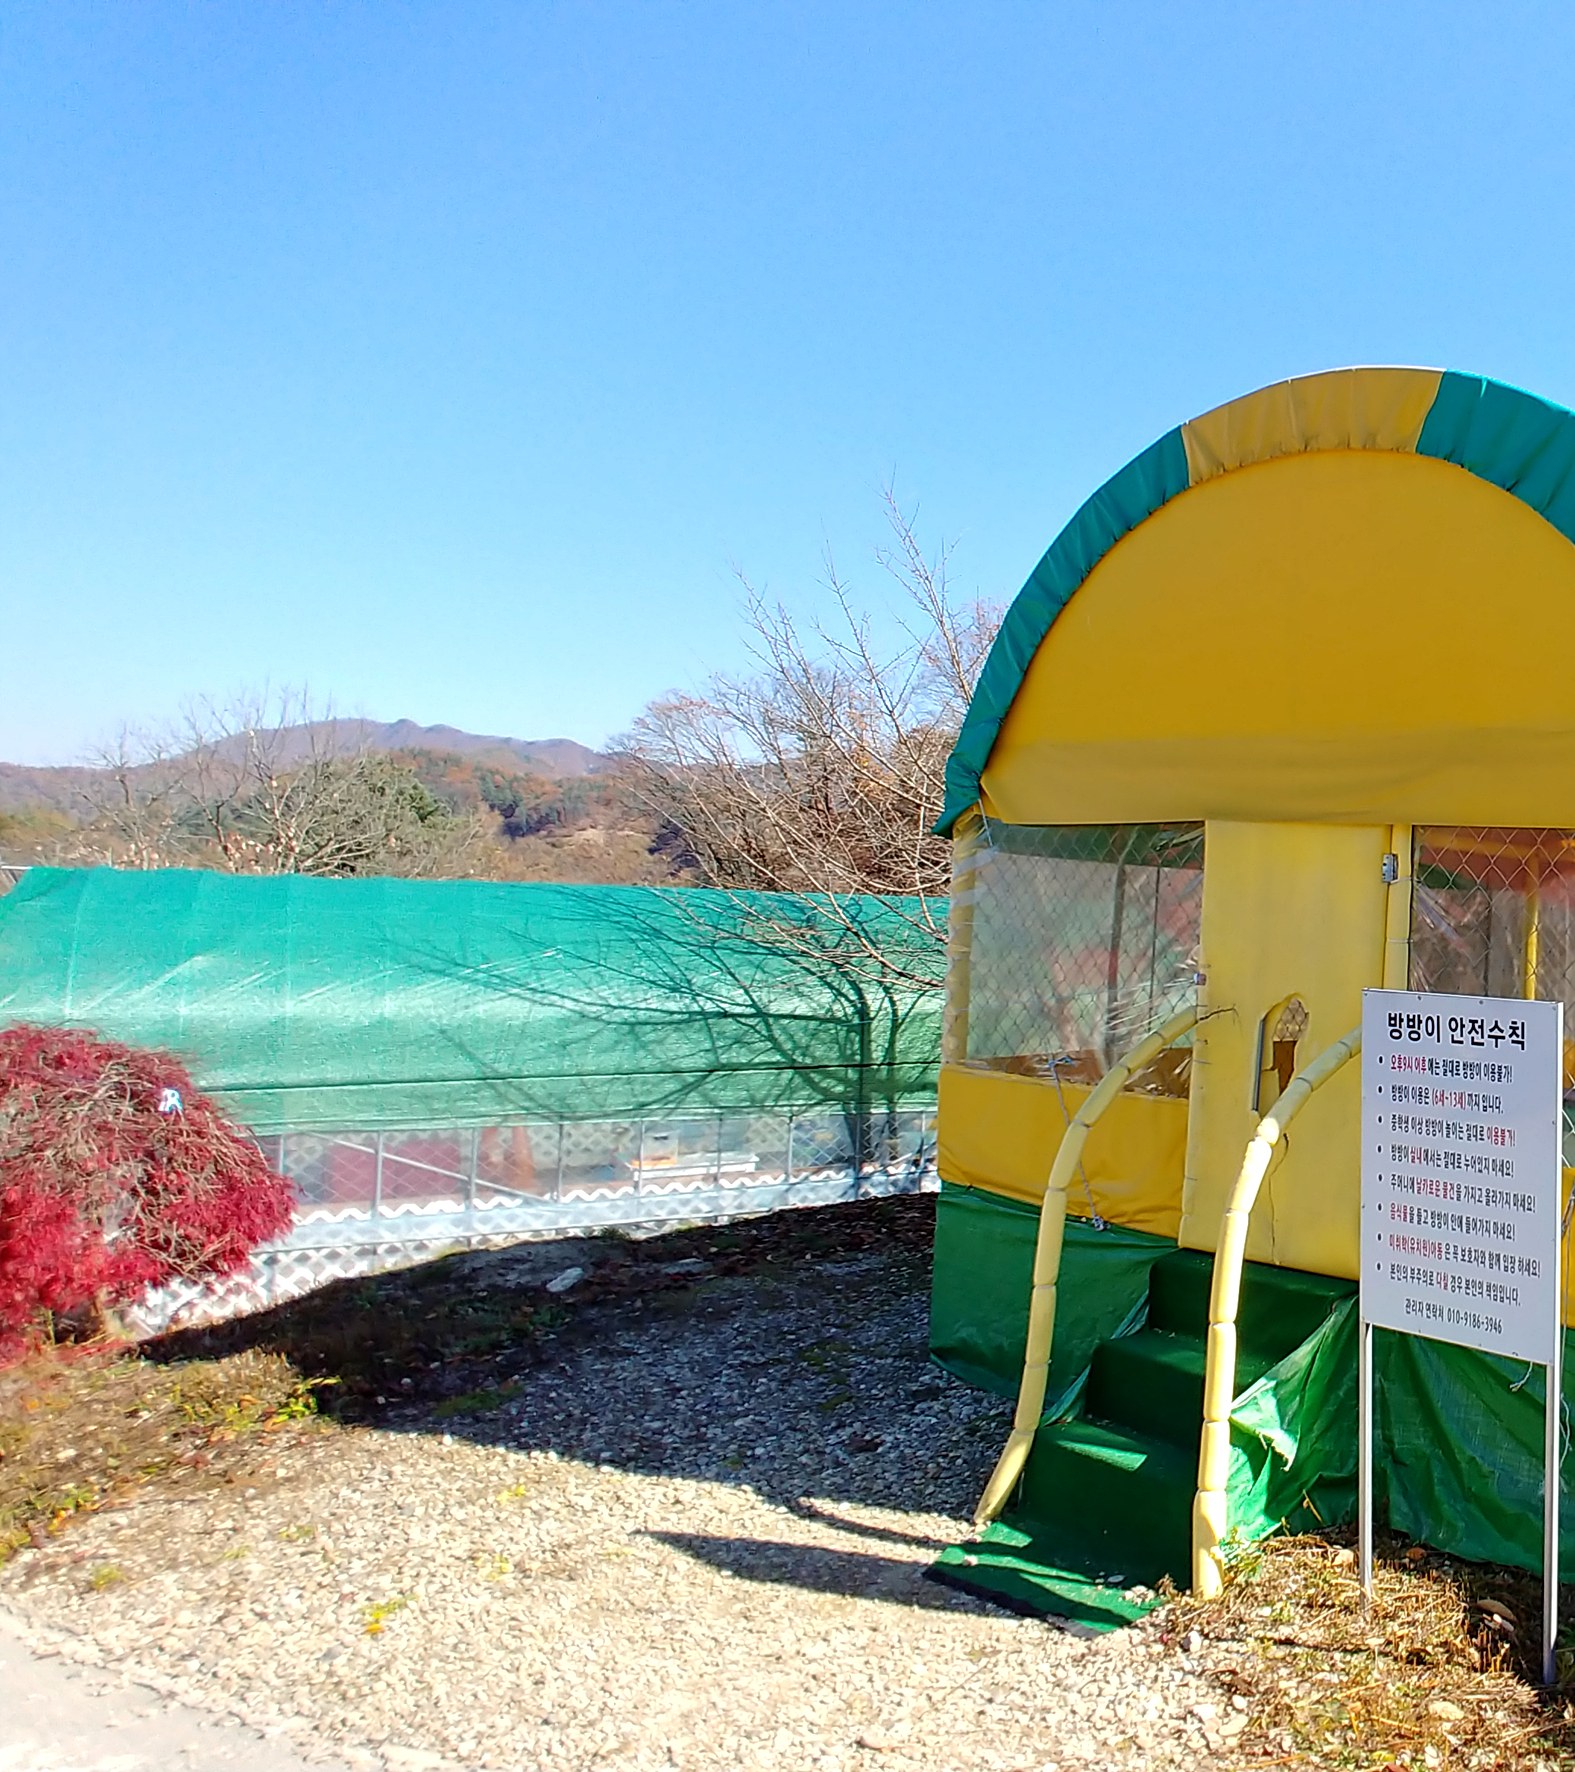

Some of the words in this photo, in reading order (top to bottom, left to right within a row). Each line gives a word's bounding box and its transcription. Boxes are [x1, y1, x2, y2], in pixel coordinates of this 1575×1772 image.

[1388, 1012, 1440, 1043] 방방이
[1448, 1016, 1525, 1050] 안전수칙
[1391, 1054, 1413, 1073] 오후9시
[1442, 1059, 1460, 1077] 절대로
[1462, 1061, 1482, 1080] 방방이
[1483, 1062, 1512, 1083] 이용불가!
[1392, 1084, 1409, 1102] 방방이
[1411, 1086, 1429, 1104] 이용은
[1391, 1114, 1409, 1133] 중학생
[1411, 1116, 1423, 1135] 이상
[1425, 1118, 1443, 1138] 방방이
[1445, 1121, 1464, 1140] 놀이는
[1466, 1124, 1485, 1142] 절대로
[1487, 1126, 1515, 1147] 이용불가!
[1391, 1144, 1409, 1163] 방방이
[1443, 1151, 1462, 1170] 절대로
[1492, 1158, 1514, 1178] 마세요!
[1391, 1173, 1415, 1194] 주머니에
[1416, 1177, 1440, 1197] 날카로운
[1464, 1185, 1483, 1204] 가지고
[1485, 1188, 1511, 1209] 올라가지
[1513, 1193, 1536, 1213] 마세요!
[1416, 1206, 1428, 1225] 들고
[1430, 1209, 1449, 1229] 방방이
[1450, 1213, 1463, 1232] 안에
[1465, 1216, 1491, 1238] 들어가지
[1493, 1221, 1515, 1241] 마세요!
[1461, 1247, 1486, 1268] 보호자와
[1488, 1251, 1500, 1270] 함께
[1390, 1262, 1408, 1282] 본인의
[1410, 1266, 1434, 1287] 부주의로
[1436, 1272, 1449, 1291] 다칠
[1450, 1275, 1463, 1294] 경우
[1465, 1279, 1483, 1298] 본인의
[1486, 1282, 1521, 1306] 책임입니다.
[1406, 1298, 1424, 1317] 관리자
[1426, 1302, 1444, 1321] 연락처
[1447, 1308, 1502, 1334] 010-9186-3946
